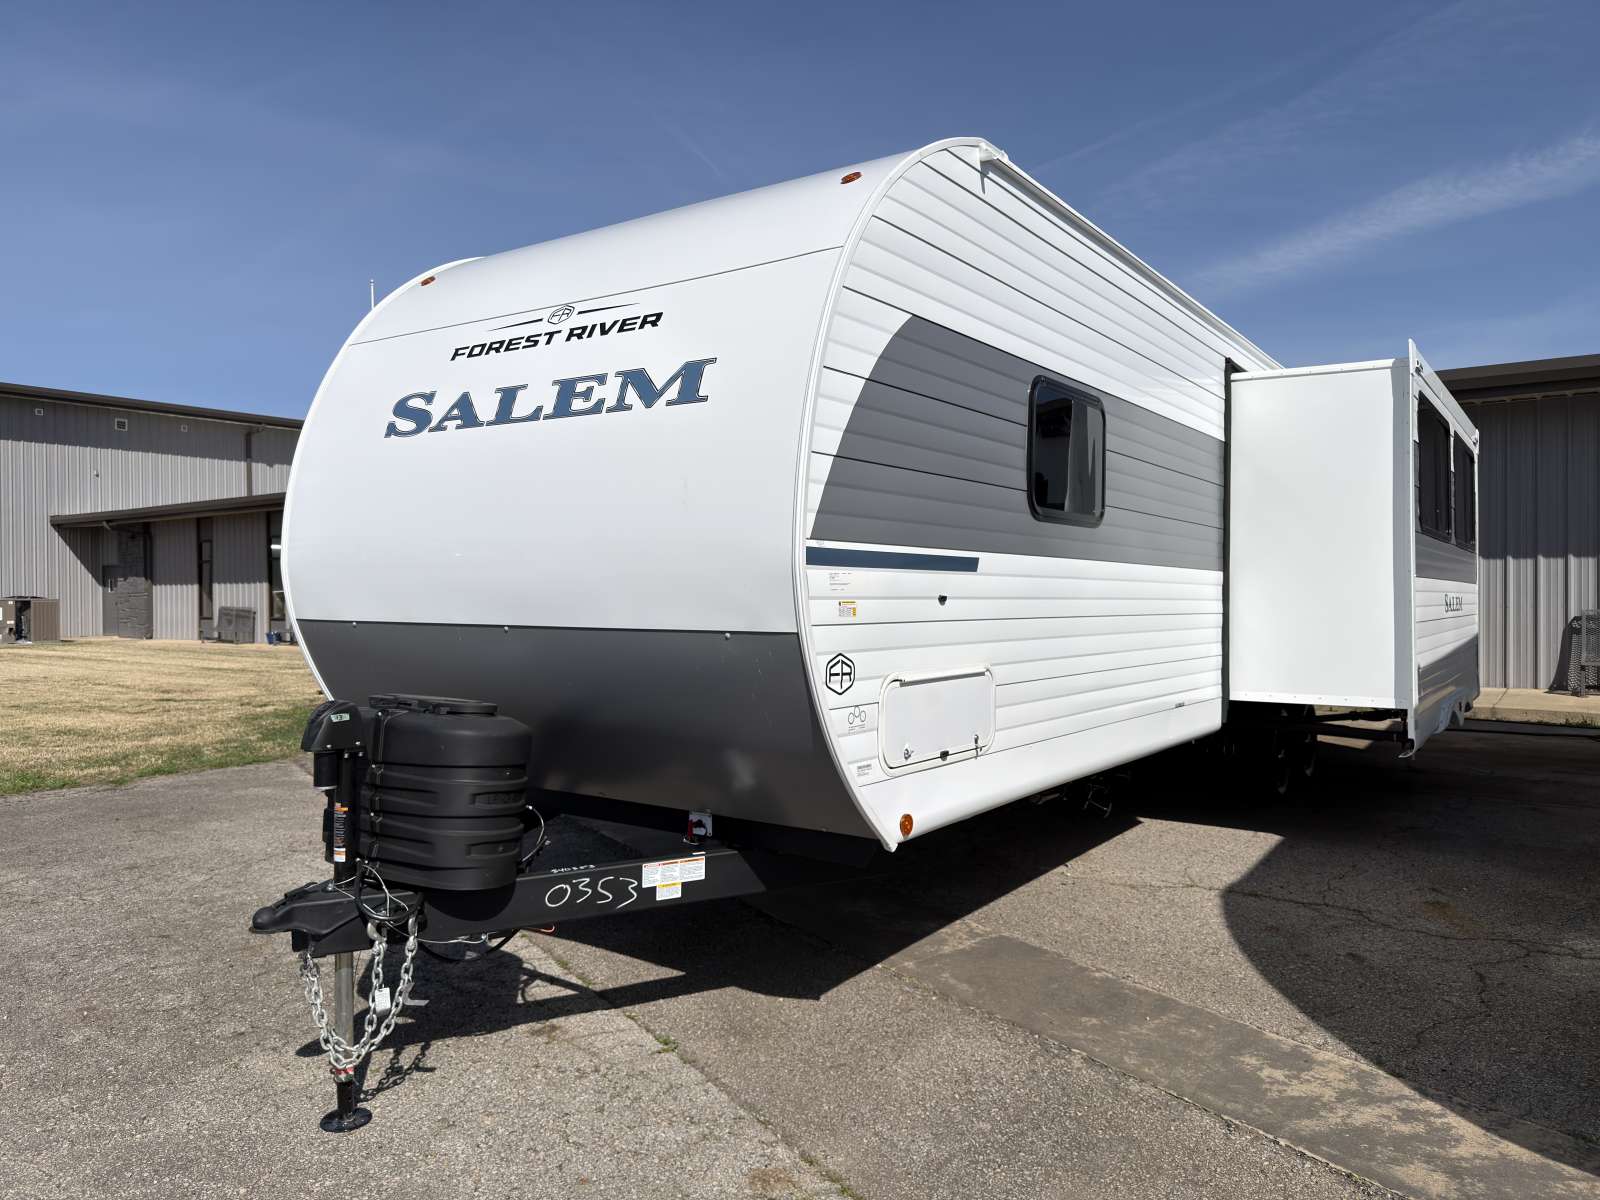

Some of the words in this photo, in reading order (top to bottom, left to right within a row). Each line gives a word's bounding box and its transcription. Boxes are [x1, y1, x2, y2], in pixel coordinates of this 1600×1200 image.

[450, 330, 562, 361] FOREST
[565, 312, 663, 342] RIVER
[385, 358, 717, 438] SALEM
[545, 877, 638, 909] 0353
